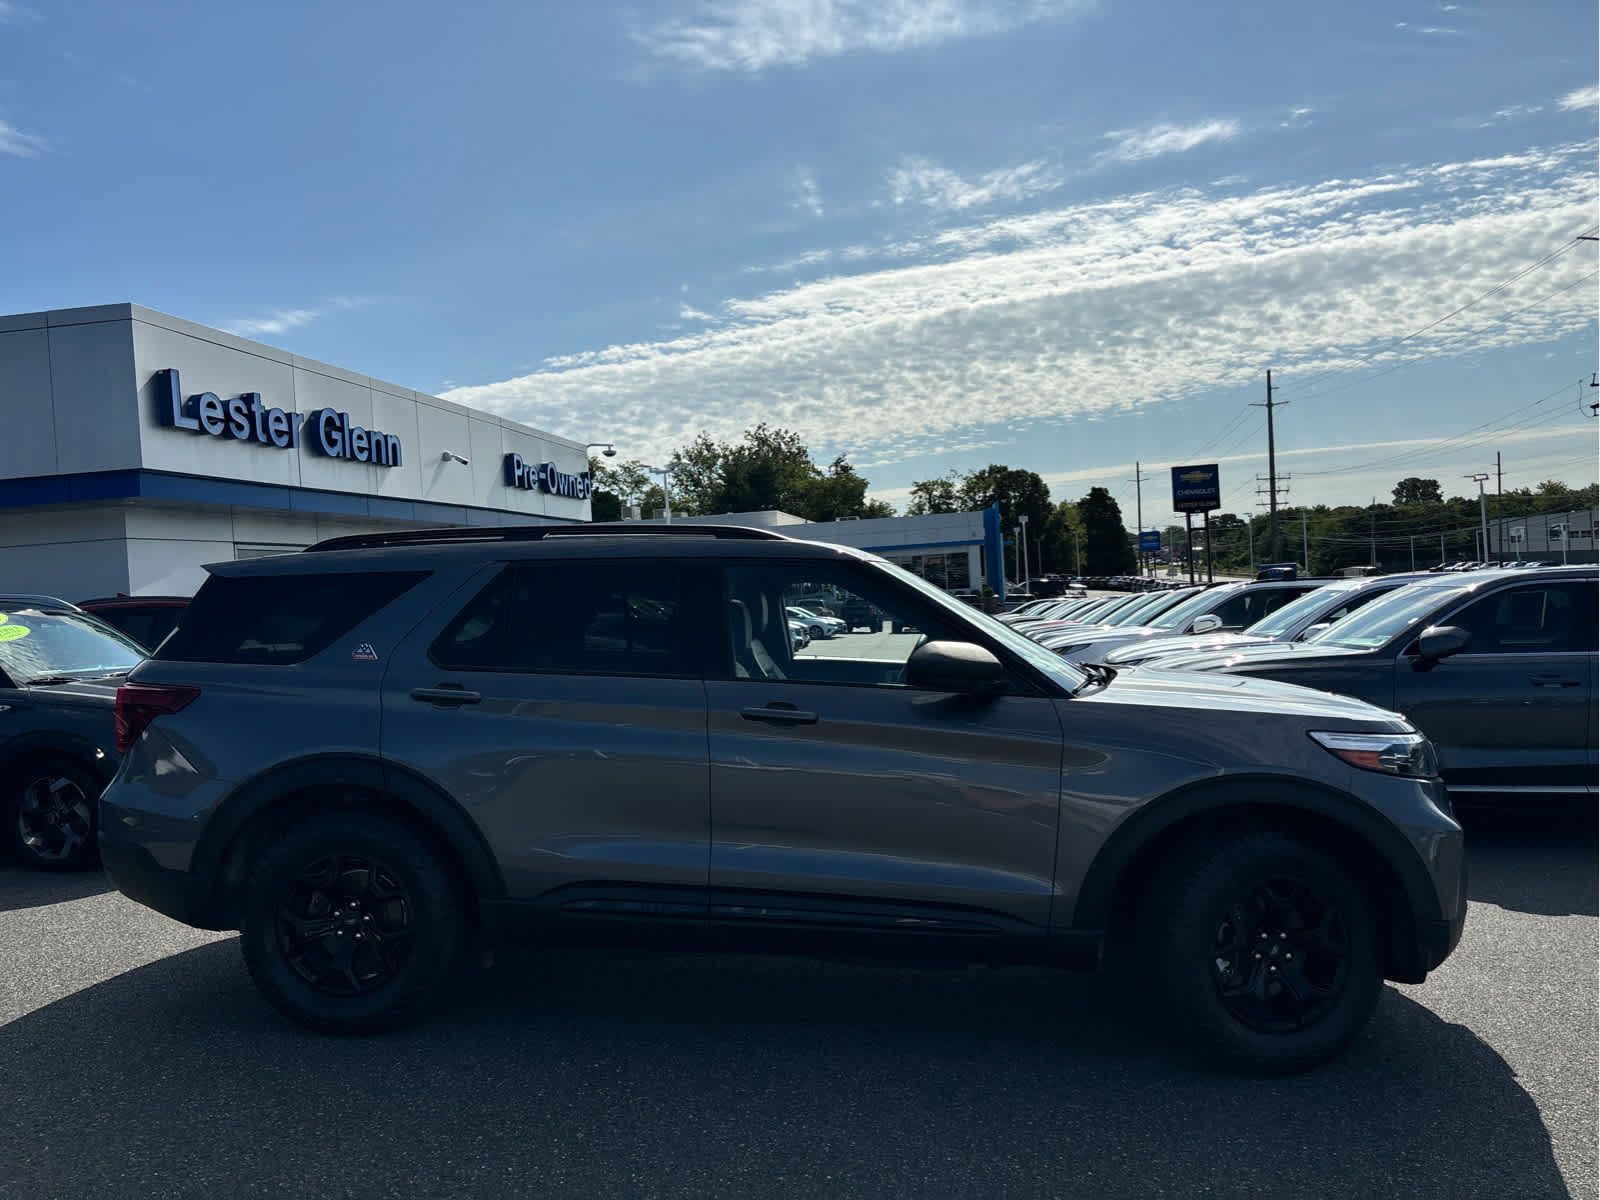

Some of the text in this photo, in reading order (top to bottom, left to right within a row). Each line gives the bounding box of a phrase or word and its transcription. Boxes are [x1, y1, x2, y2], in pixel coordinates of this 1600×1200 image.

[157, 368, 402, 467] Lester Glenn
[508, 453, 592, 500] Pre-Owned
